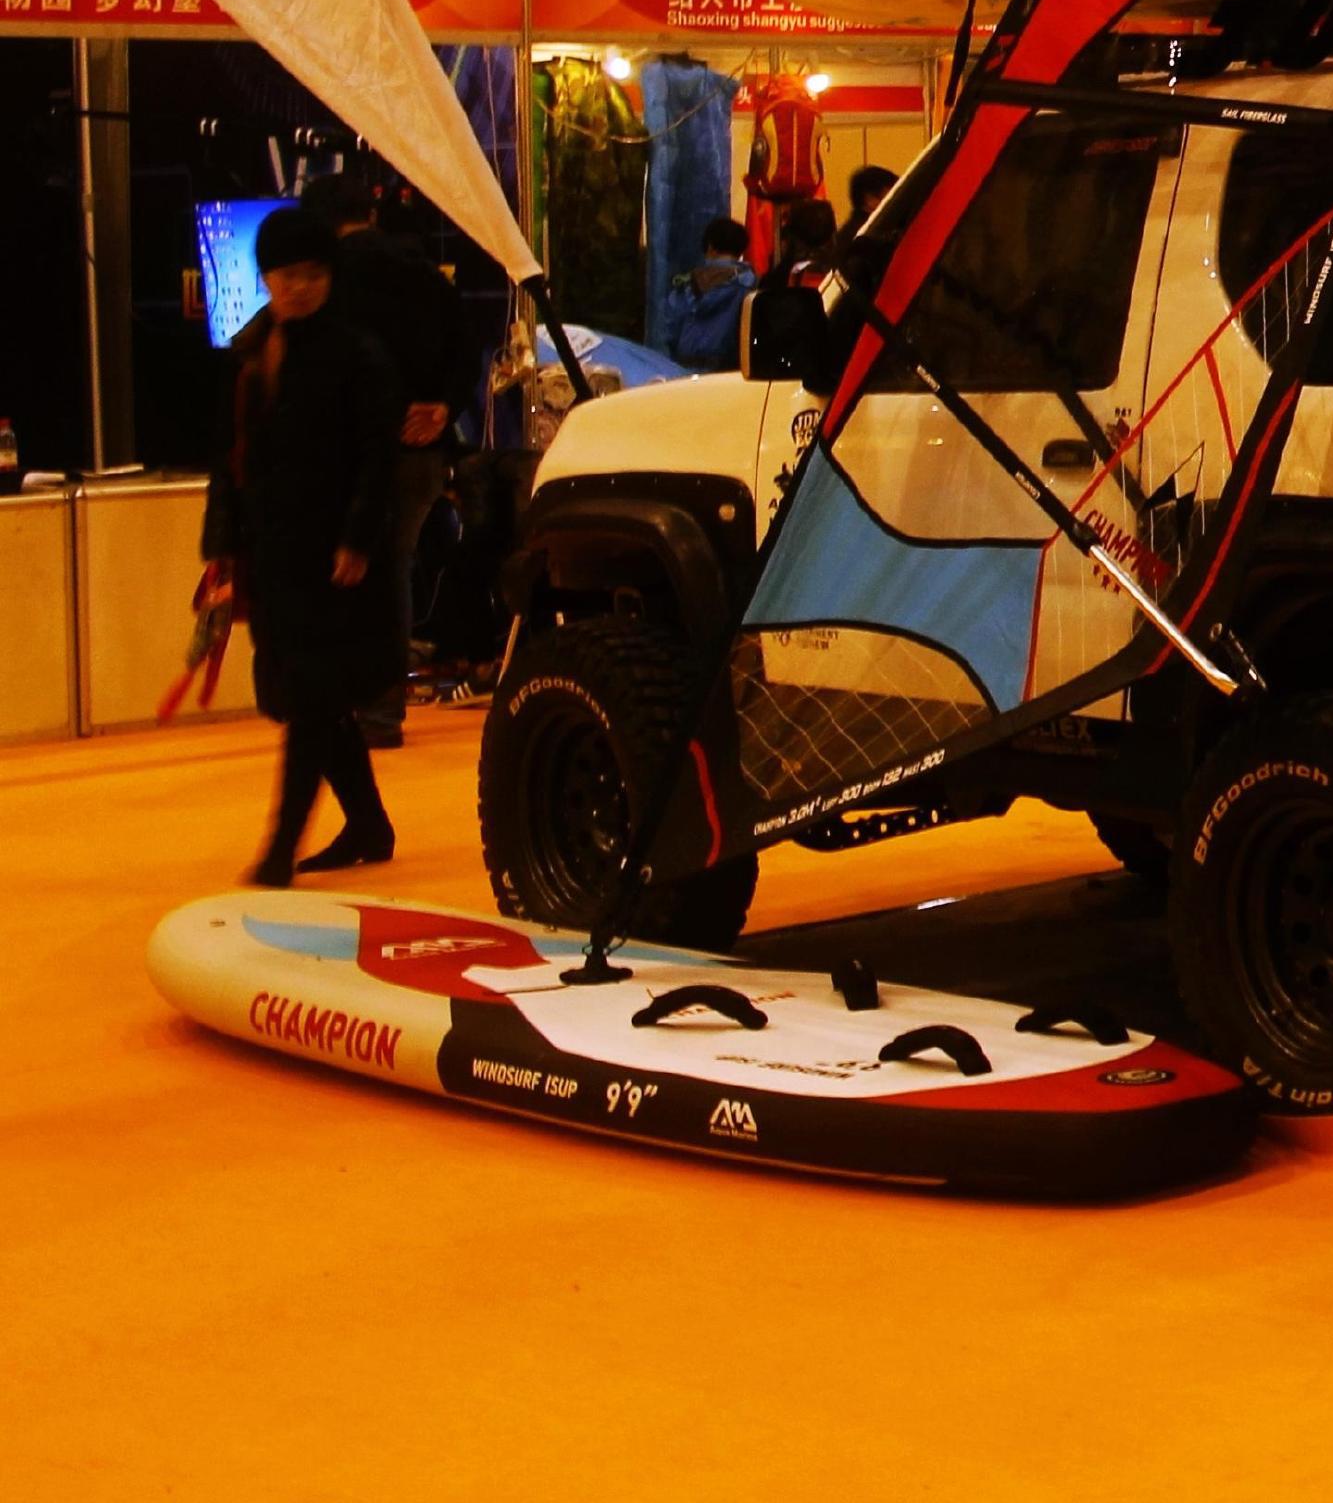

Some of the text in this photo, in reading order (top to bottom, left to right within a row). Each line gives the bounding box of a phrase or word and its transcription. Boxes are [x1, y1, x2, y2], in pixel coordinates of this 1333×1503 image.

[667, 10, 739, 29] Shaoxing
[743, 10, 807, 32] shangyu
[1221, 108, 1288, 125] SAIL FIBERGLASS
[1303, 255, 1332, 325] WINDSURF
[1193, 759, 1330, 865] BFGoodrich
[249, 991, 402, 1071] CHAMPION
[472, 1058, 543, 1092] WINDSURF
[543, 1073, 579, 1099] ISUP
